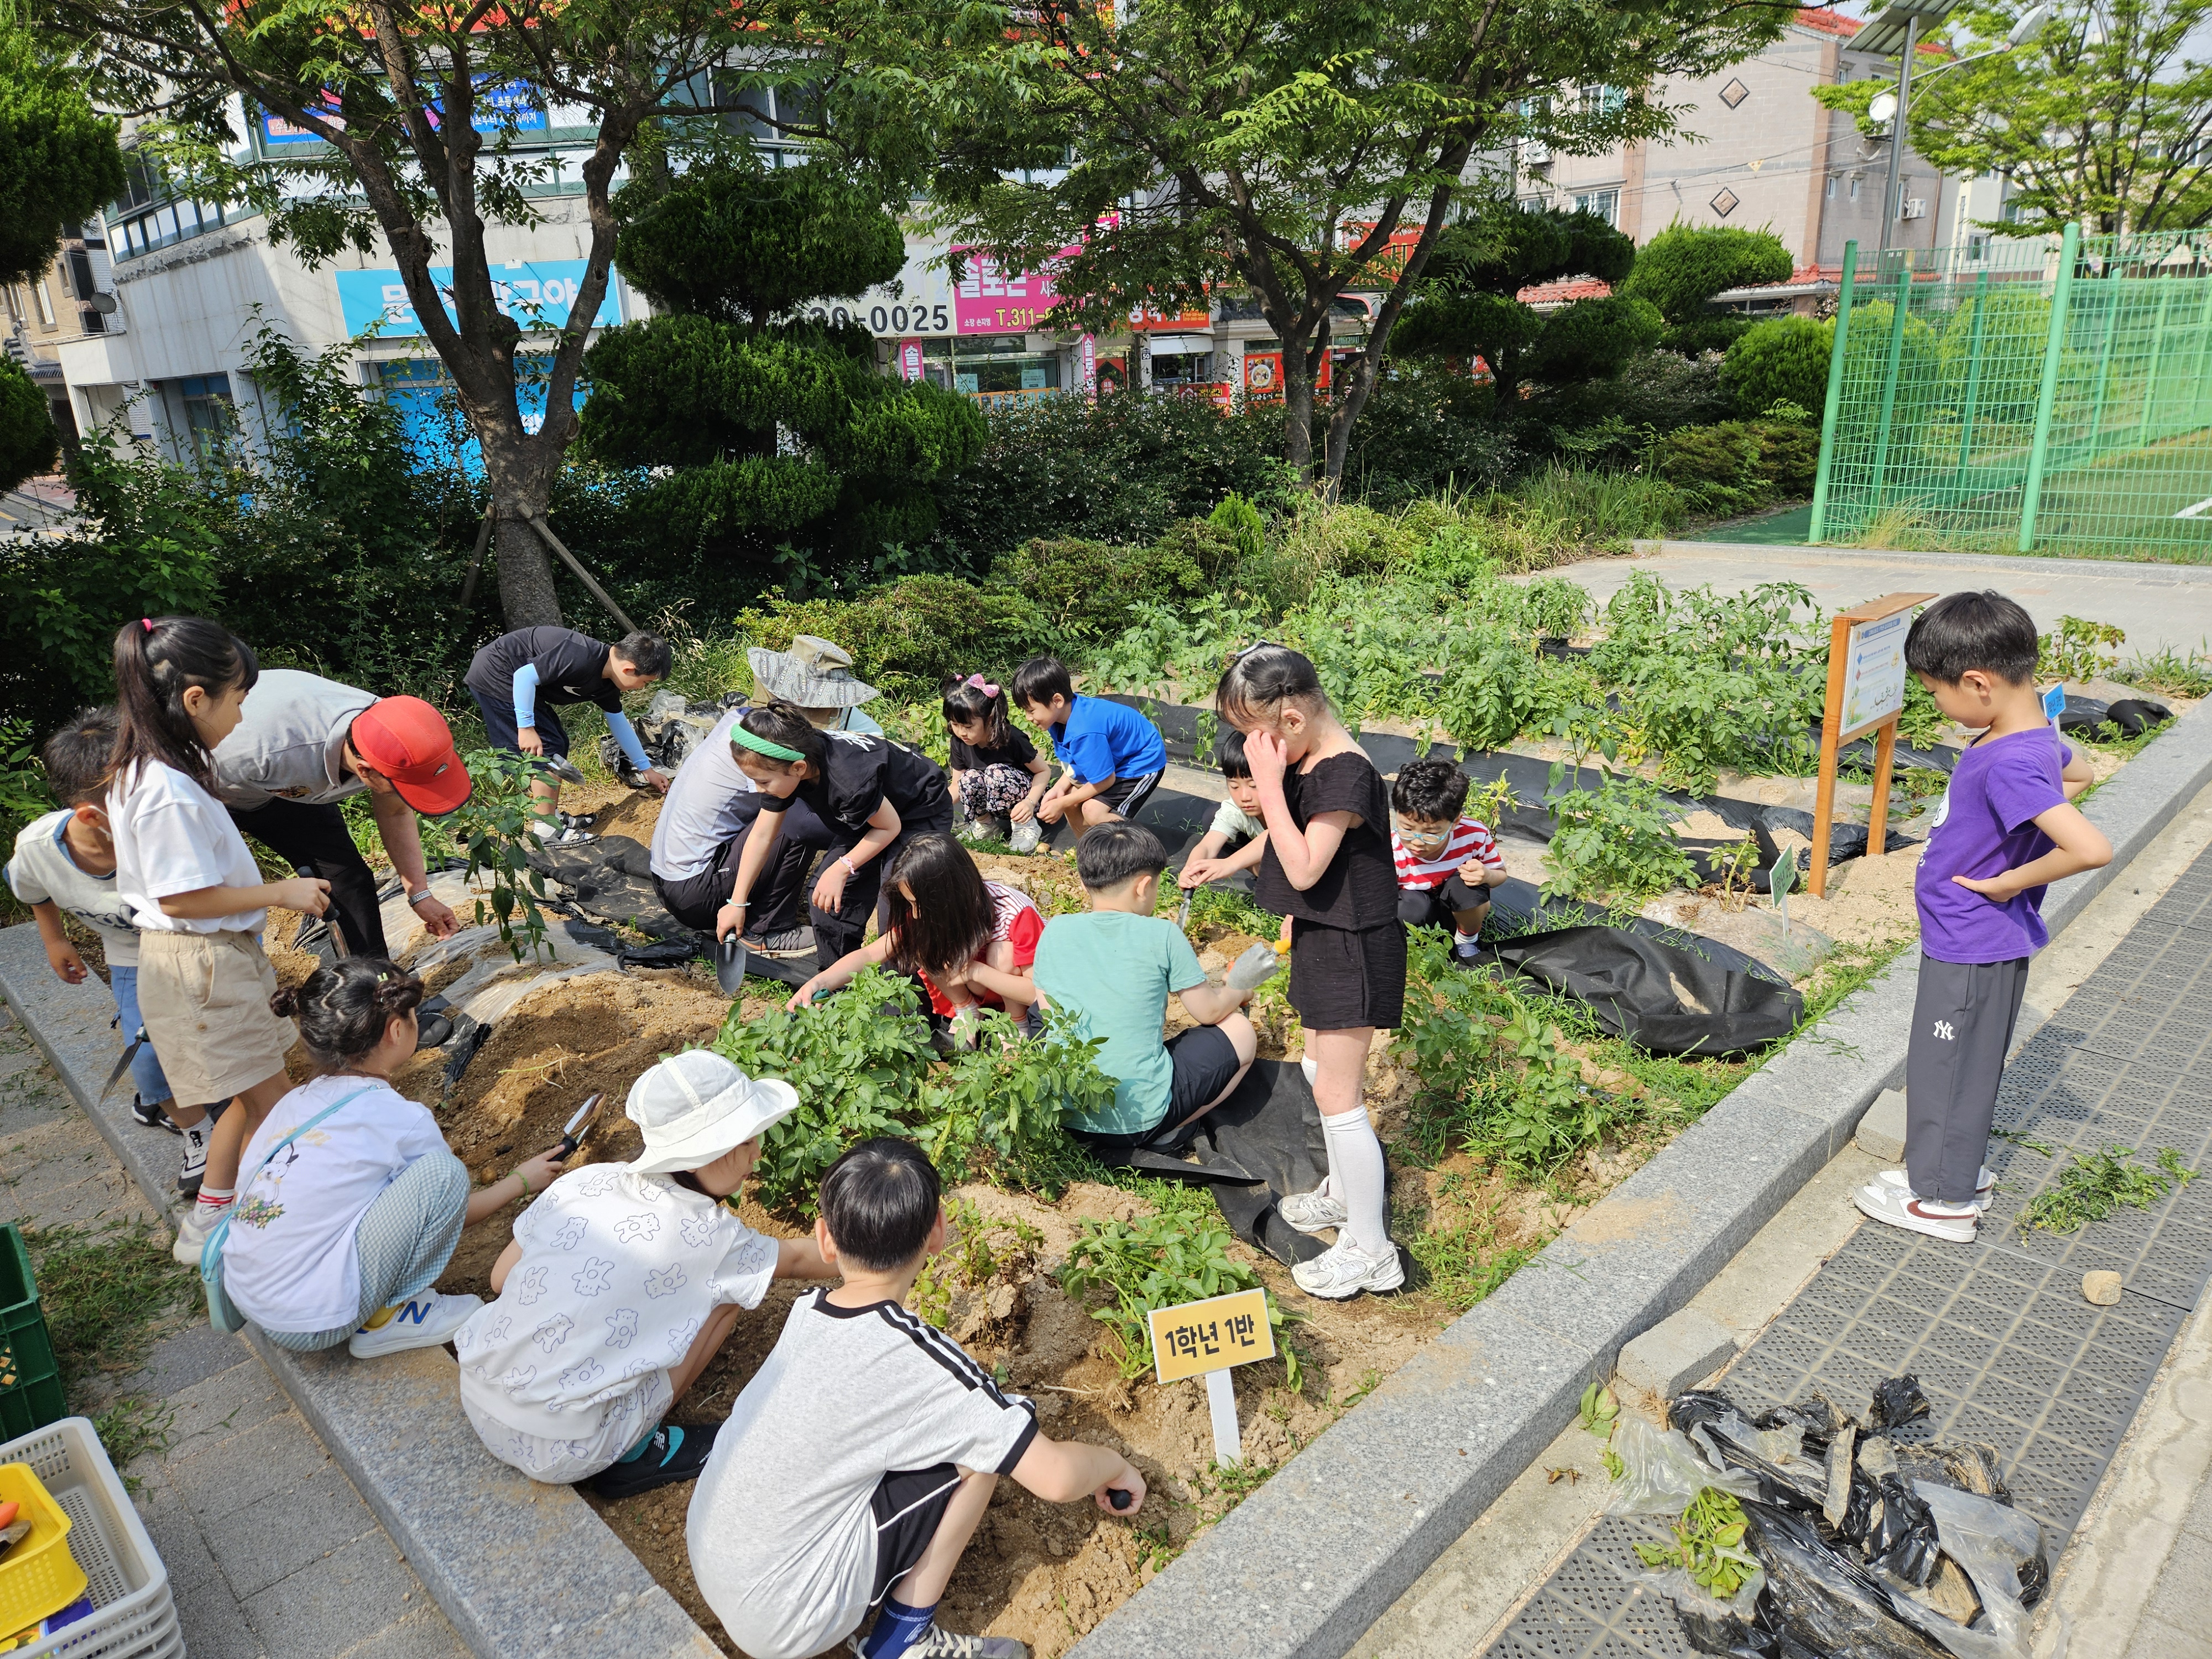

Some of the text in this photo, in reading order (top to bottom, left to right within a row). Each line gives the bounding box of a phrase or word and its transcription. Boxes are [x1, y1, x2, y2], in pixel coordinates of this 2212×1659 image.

[1774, 858, 1792, 895] 1학년 2반
[1165, 1314, 1255, 1358] 1학년 1반
